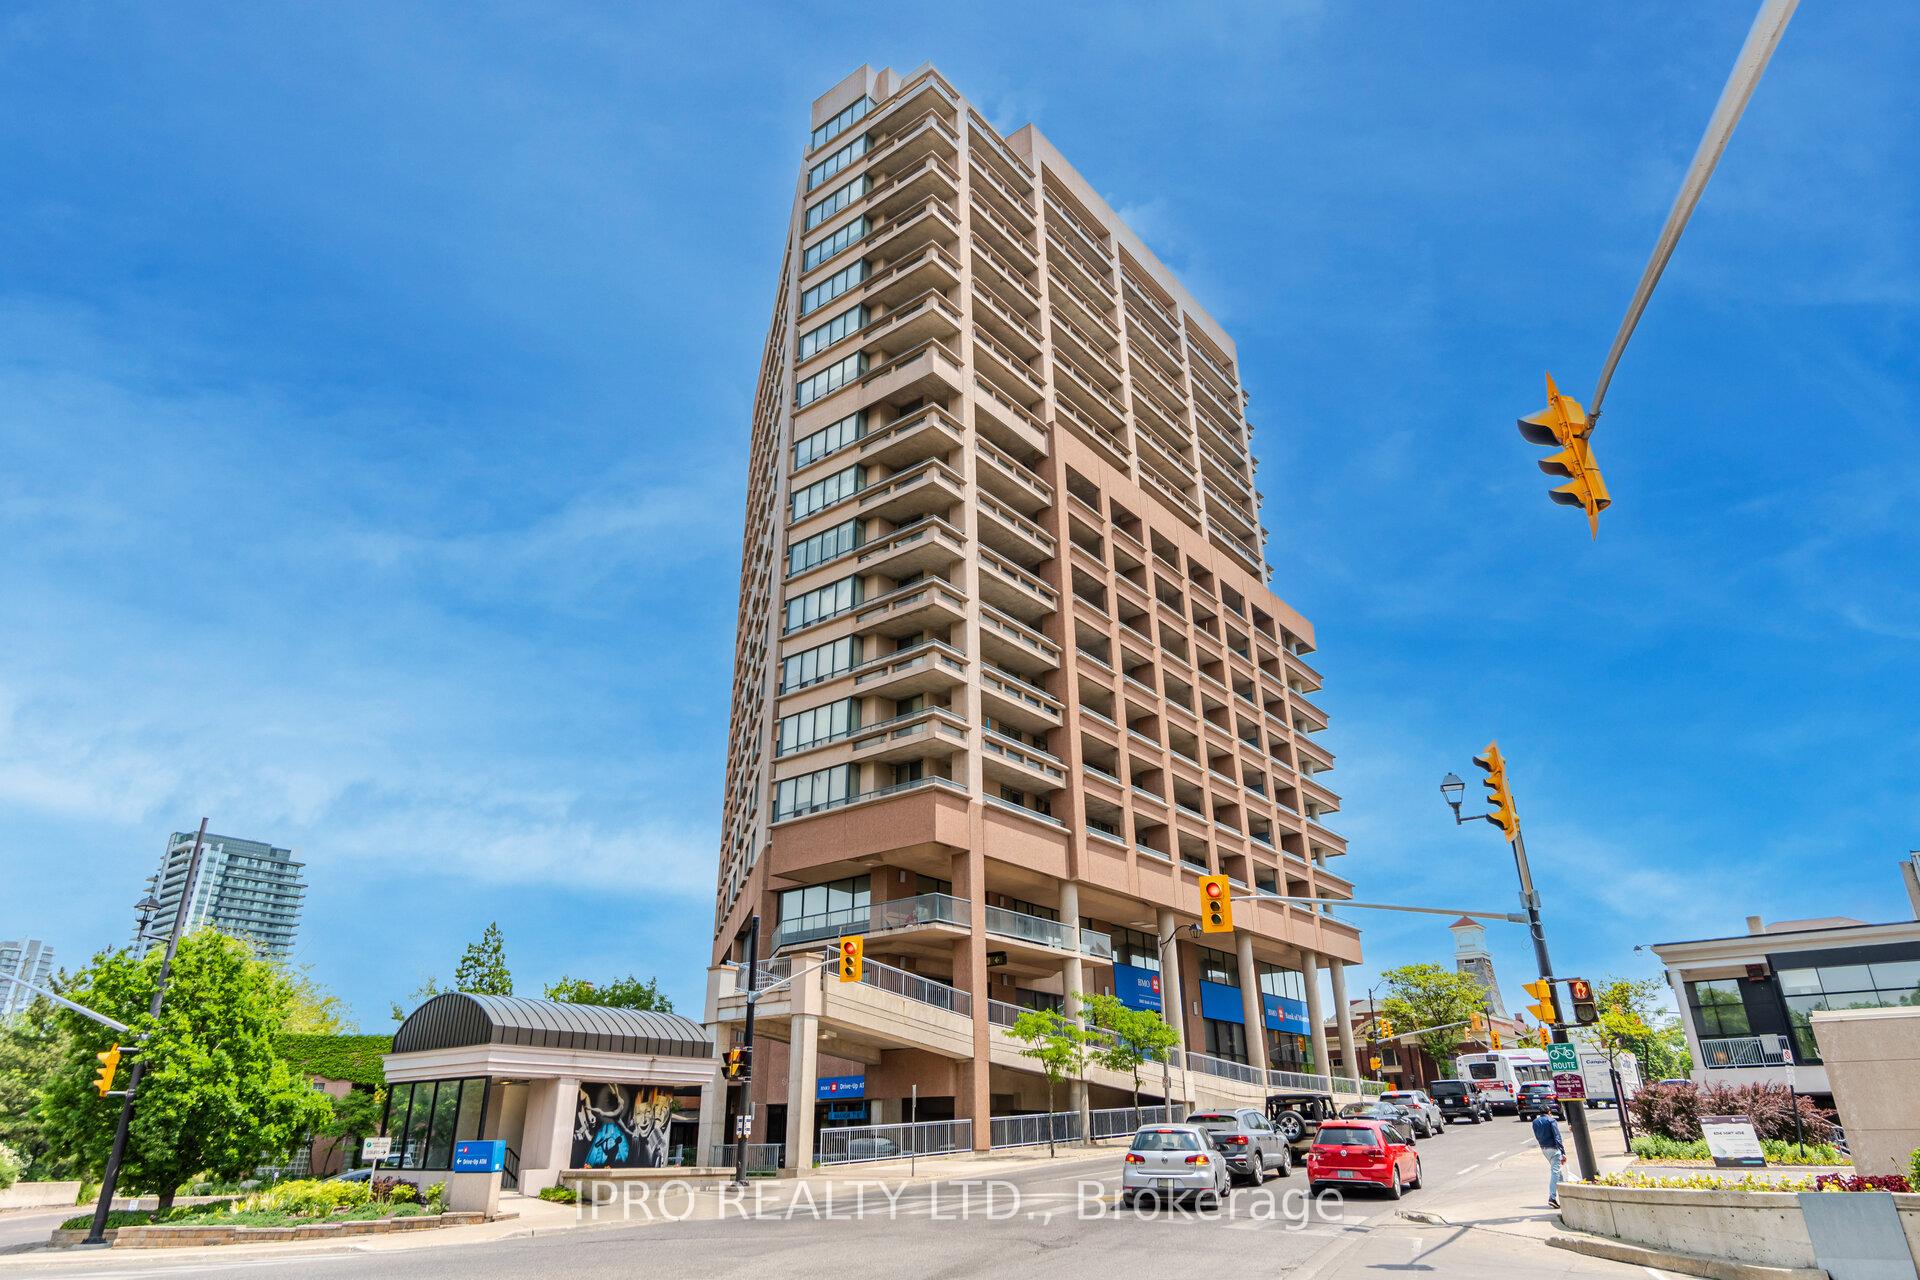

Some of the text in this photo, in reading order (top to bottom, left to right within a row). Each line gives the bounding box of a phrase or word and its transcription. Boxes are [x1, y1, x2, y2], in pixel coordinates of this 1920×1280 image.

[1137, 978, 1150, 988] BMO
[1267, 1008, 1278, 1017] BMO
[1553, 1061, 1576, 1069] ROUTE
